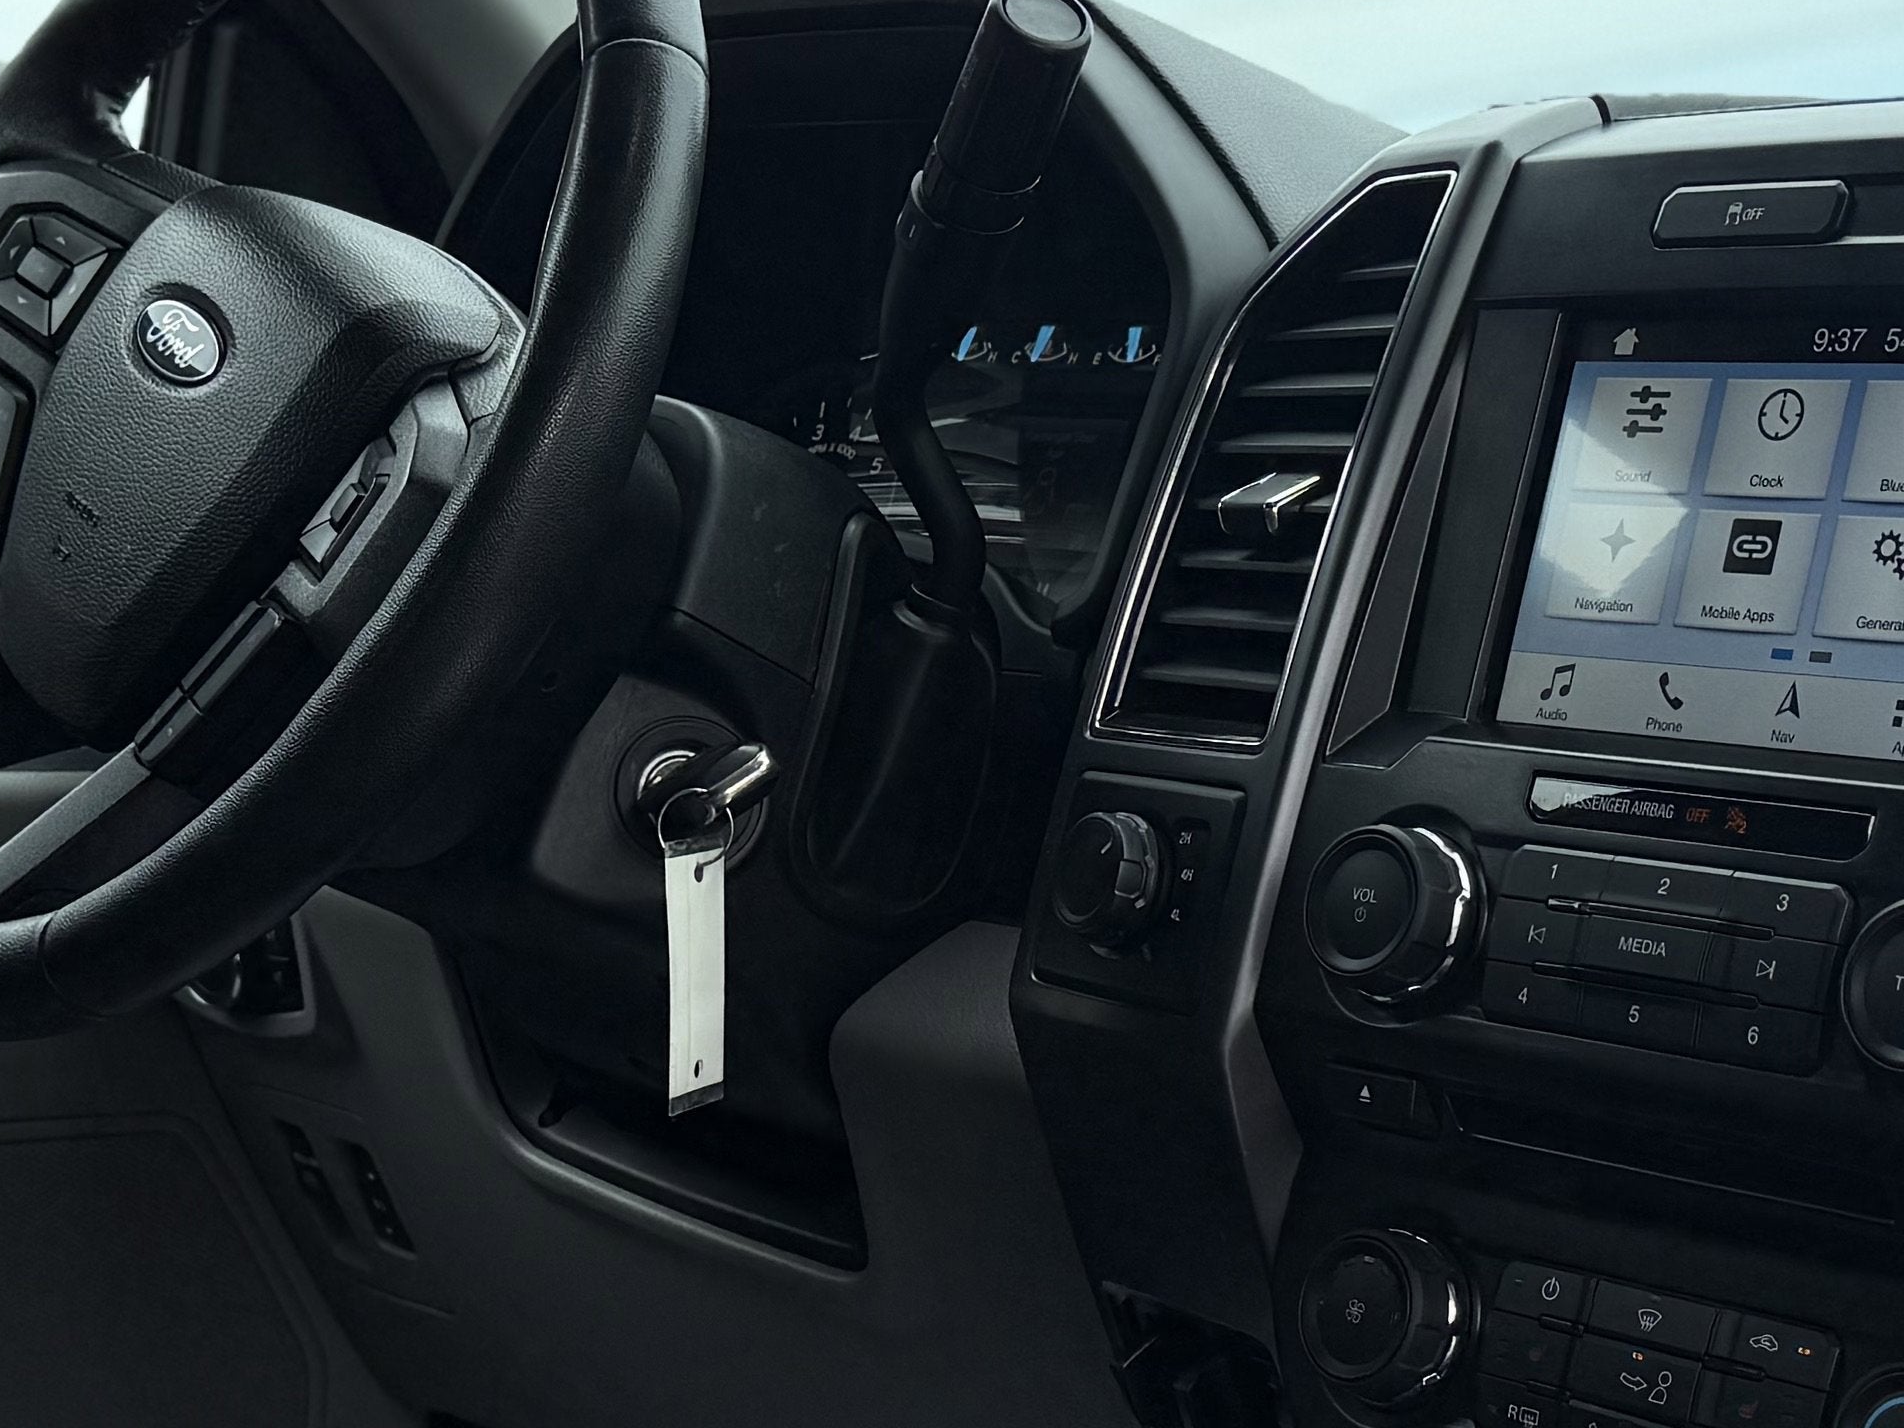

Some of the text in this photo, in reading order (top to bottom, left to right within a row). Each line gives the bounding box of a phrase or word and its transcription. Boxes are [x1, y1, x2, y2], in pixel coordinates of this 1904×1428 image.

[1812, 328, 1868, 353] 9:37
[1749, 473, 1785, 490] Clock
[1573, 596, 1634, 615] Navigation
[1699, 604, 1776, 627] Mobile Apps
[1535, 705, 1568, 722] Audio
[1645, 715, 1683, 734] Phone
[1769, 728, 1796, 745] Nav
[1630, 800, 1675, 820] AIRBAG
[1686, 807, 1712, 823] OFF
[1549, 862, 1559, 880] 1
[1352, 886, 1379, 906] VOL
[1657, 877, 1671, 896] 2
[1776, 893, 1790, 913] 3
[1617, 935, 1668, 959] MEDIA
[1517, 987, 1529, 1006] 4
[1628, 1005, 1641, 1025] 5
[1746, 1026, 1760, 1046] 6
